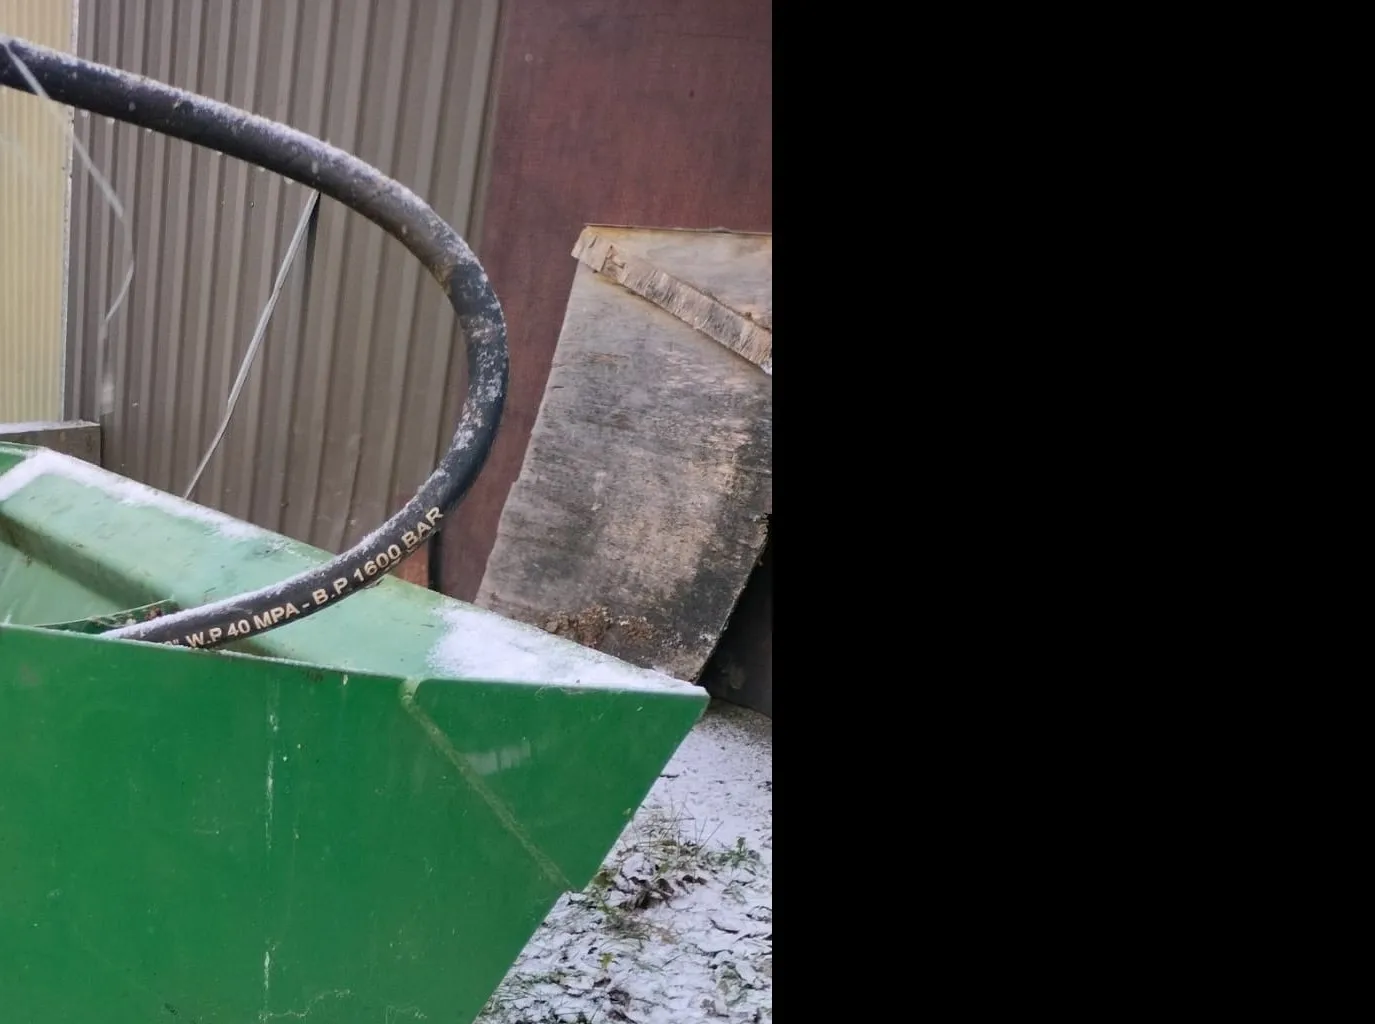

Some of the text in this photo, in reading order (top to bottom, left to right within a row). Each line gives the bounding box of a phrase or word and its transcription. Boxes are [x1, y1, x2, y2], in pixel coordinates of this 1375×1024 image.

[227, 619, 251, 637] 40
[254, 602, 300, 631] MPA
[312, 577, 348, 605] B.P
[354, 544, 402, 582] 1600
[401, 506, 444, 549] BAR
